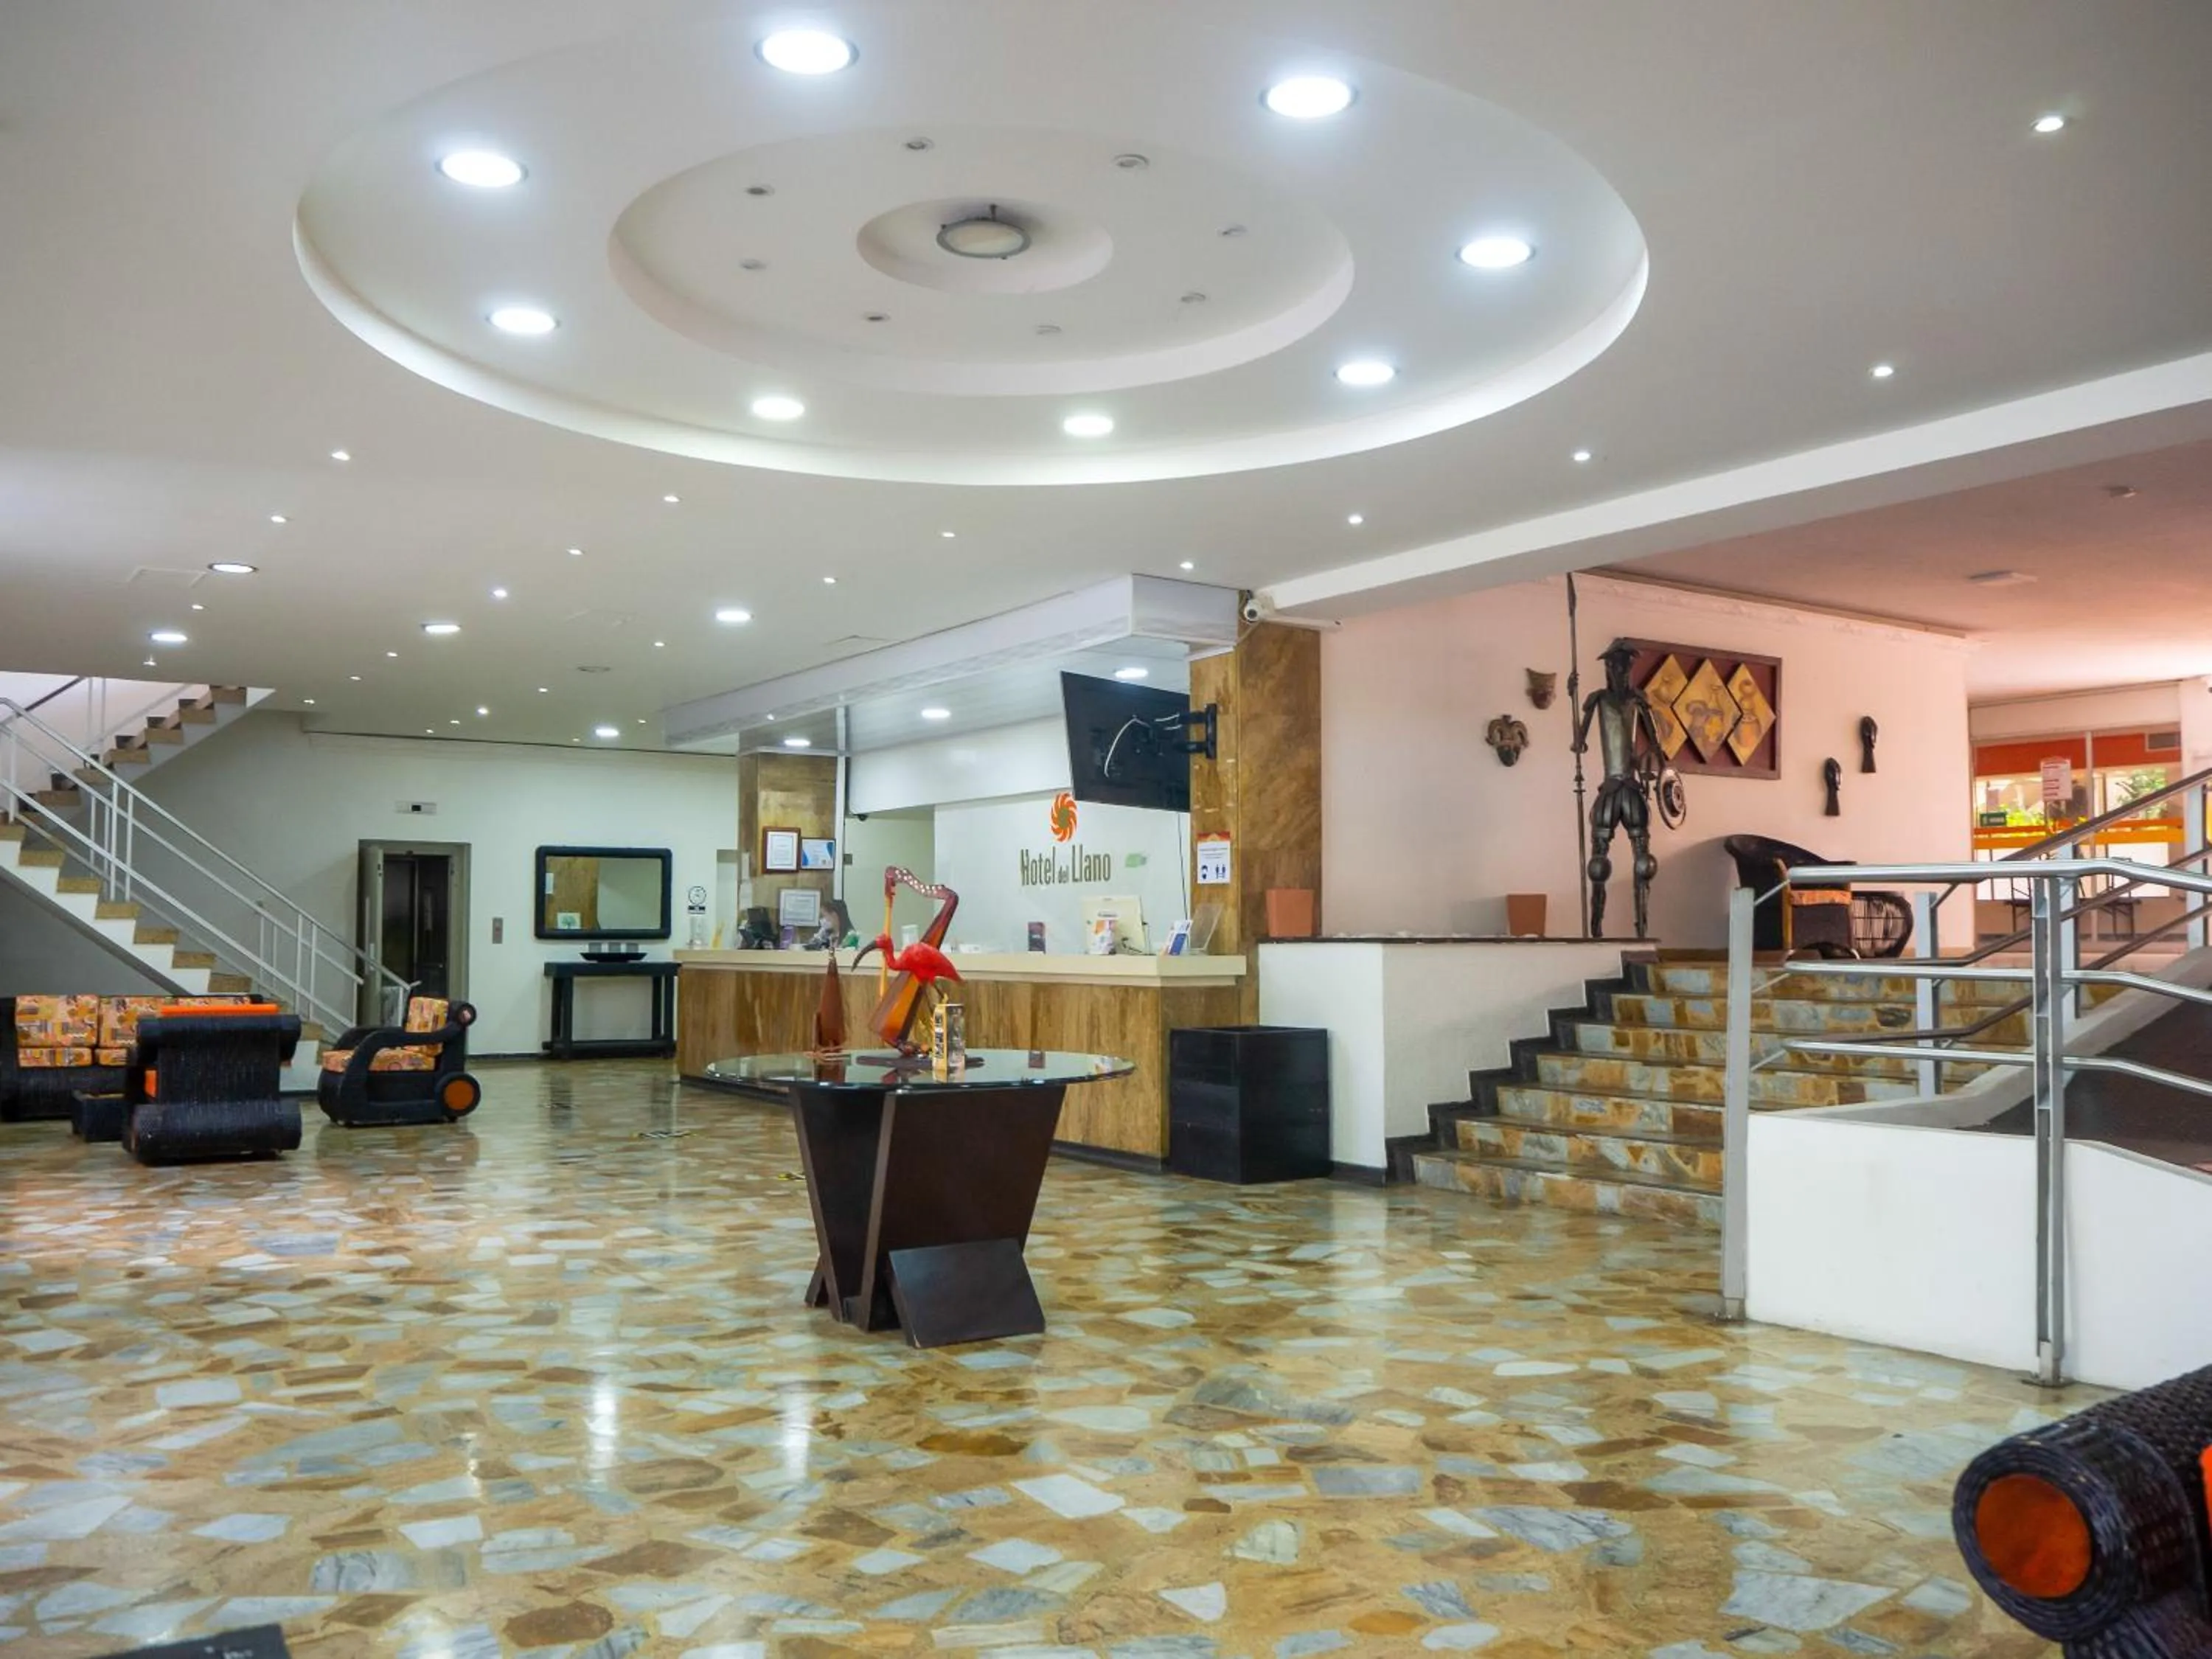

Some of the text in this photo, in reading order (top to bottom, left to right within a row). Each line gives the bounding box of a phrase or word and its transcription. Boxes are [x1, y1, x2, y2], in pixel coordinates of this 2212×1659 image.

[1020, 844, 1111, 886] Hotel del Llano
